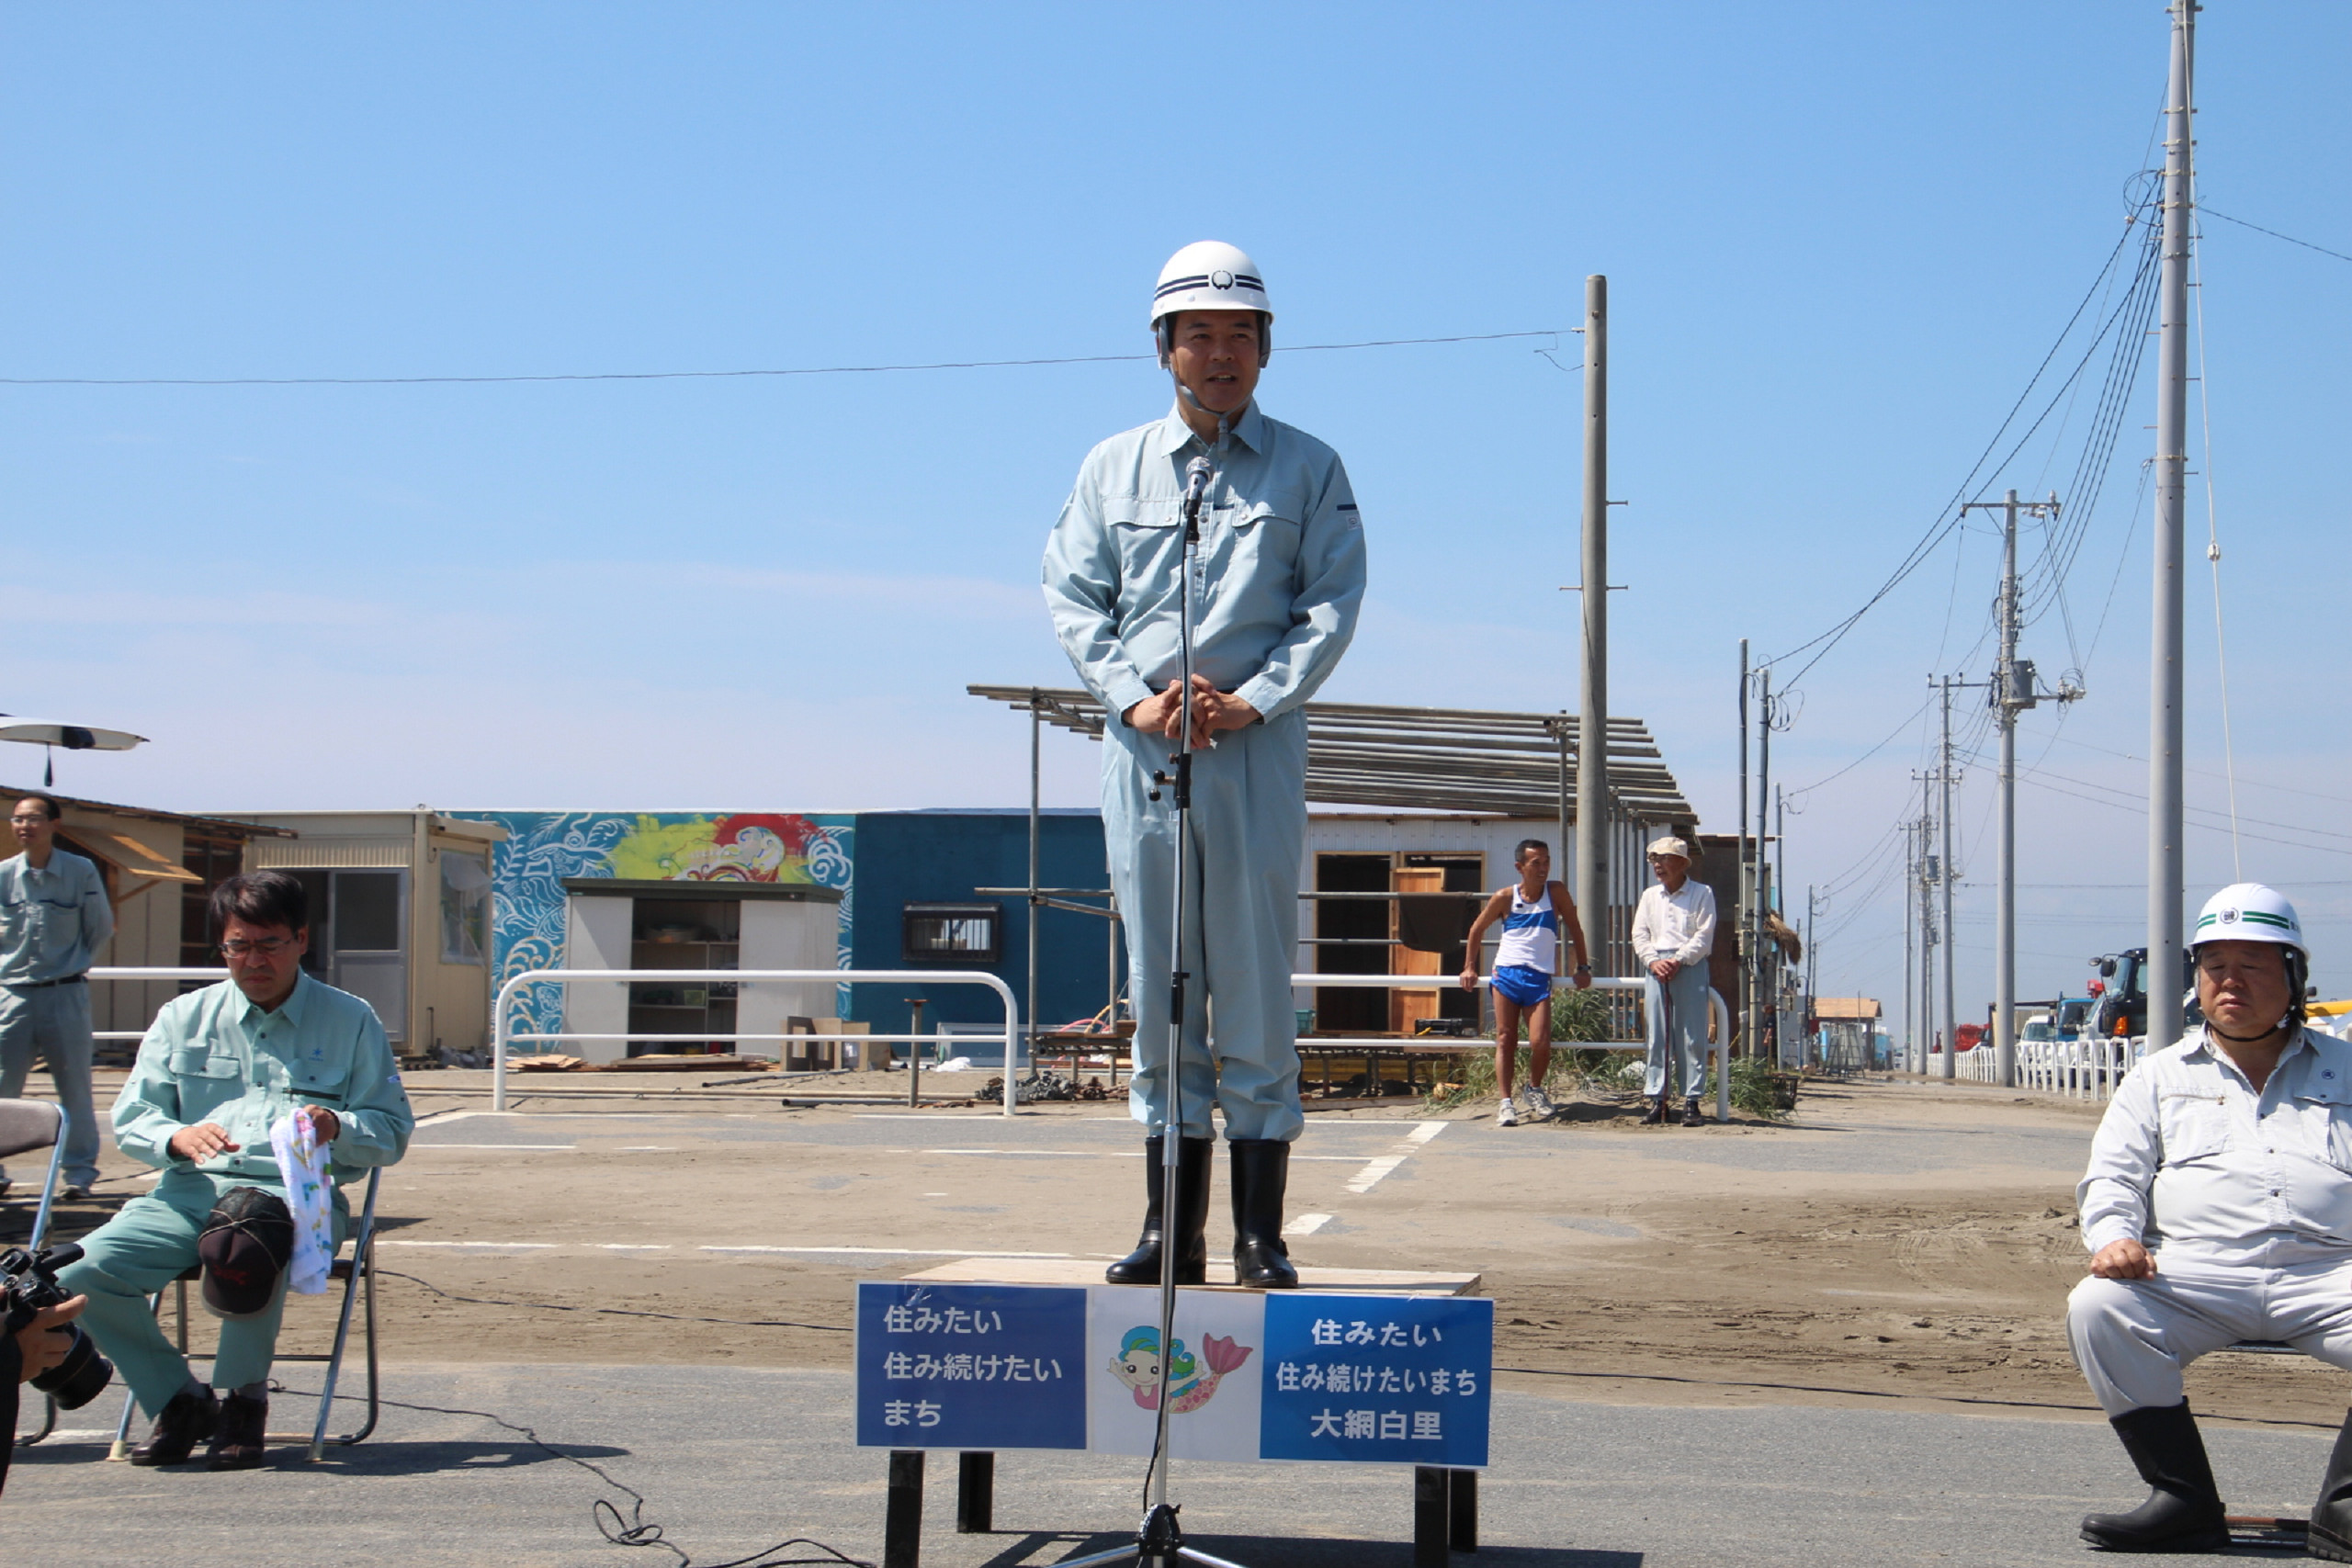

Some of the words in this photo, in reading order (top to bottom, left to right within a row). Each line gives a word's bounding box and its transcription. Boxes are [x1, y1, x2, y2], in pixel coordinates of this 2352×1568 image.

[883, 1304, 1002, 1334] 住みたい
[1311, 1318, 1442, 1348] 住みたい
[883, 1351, 1062, 1382] 住み続けたい
[1275, 1361, 1477, 1396] 住み続けたいまち
[884, 1399, 942, 1427] まち
[1310, 1408, 1442, 1440] 大網白里
